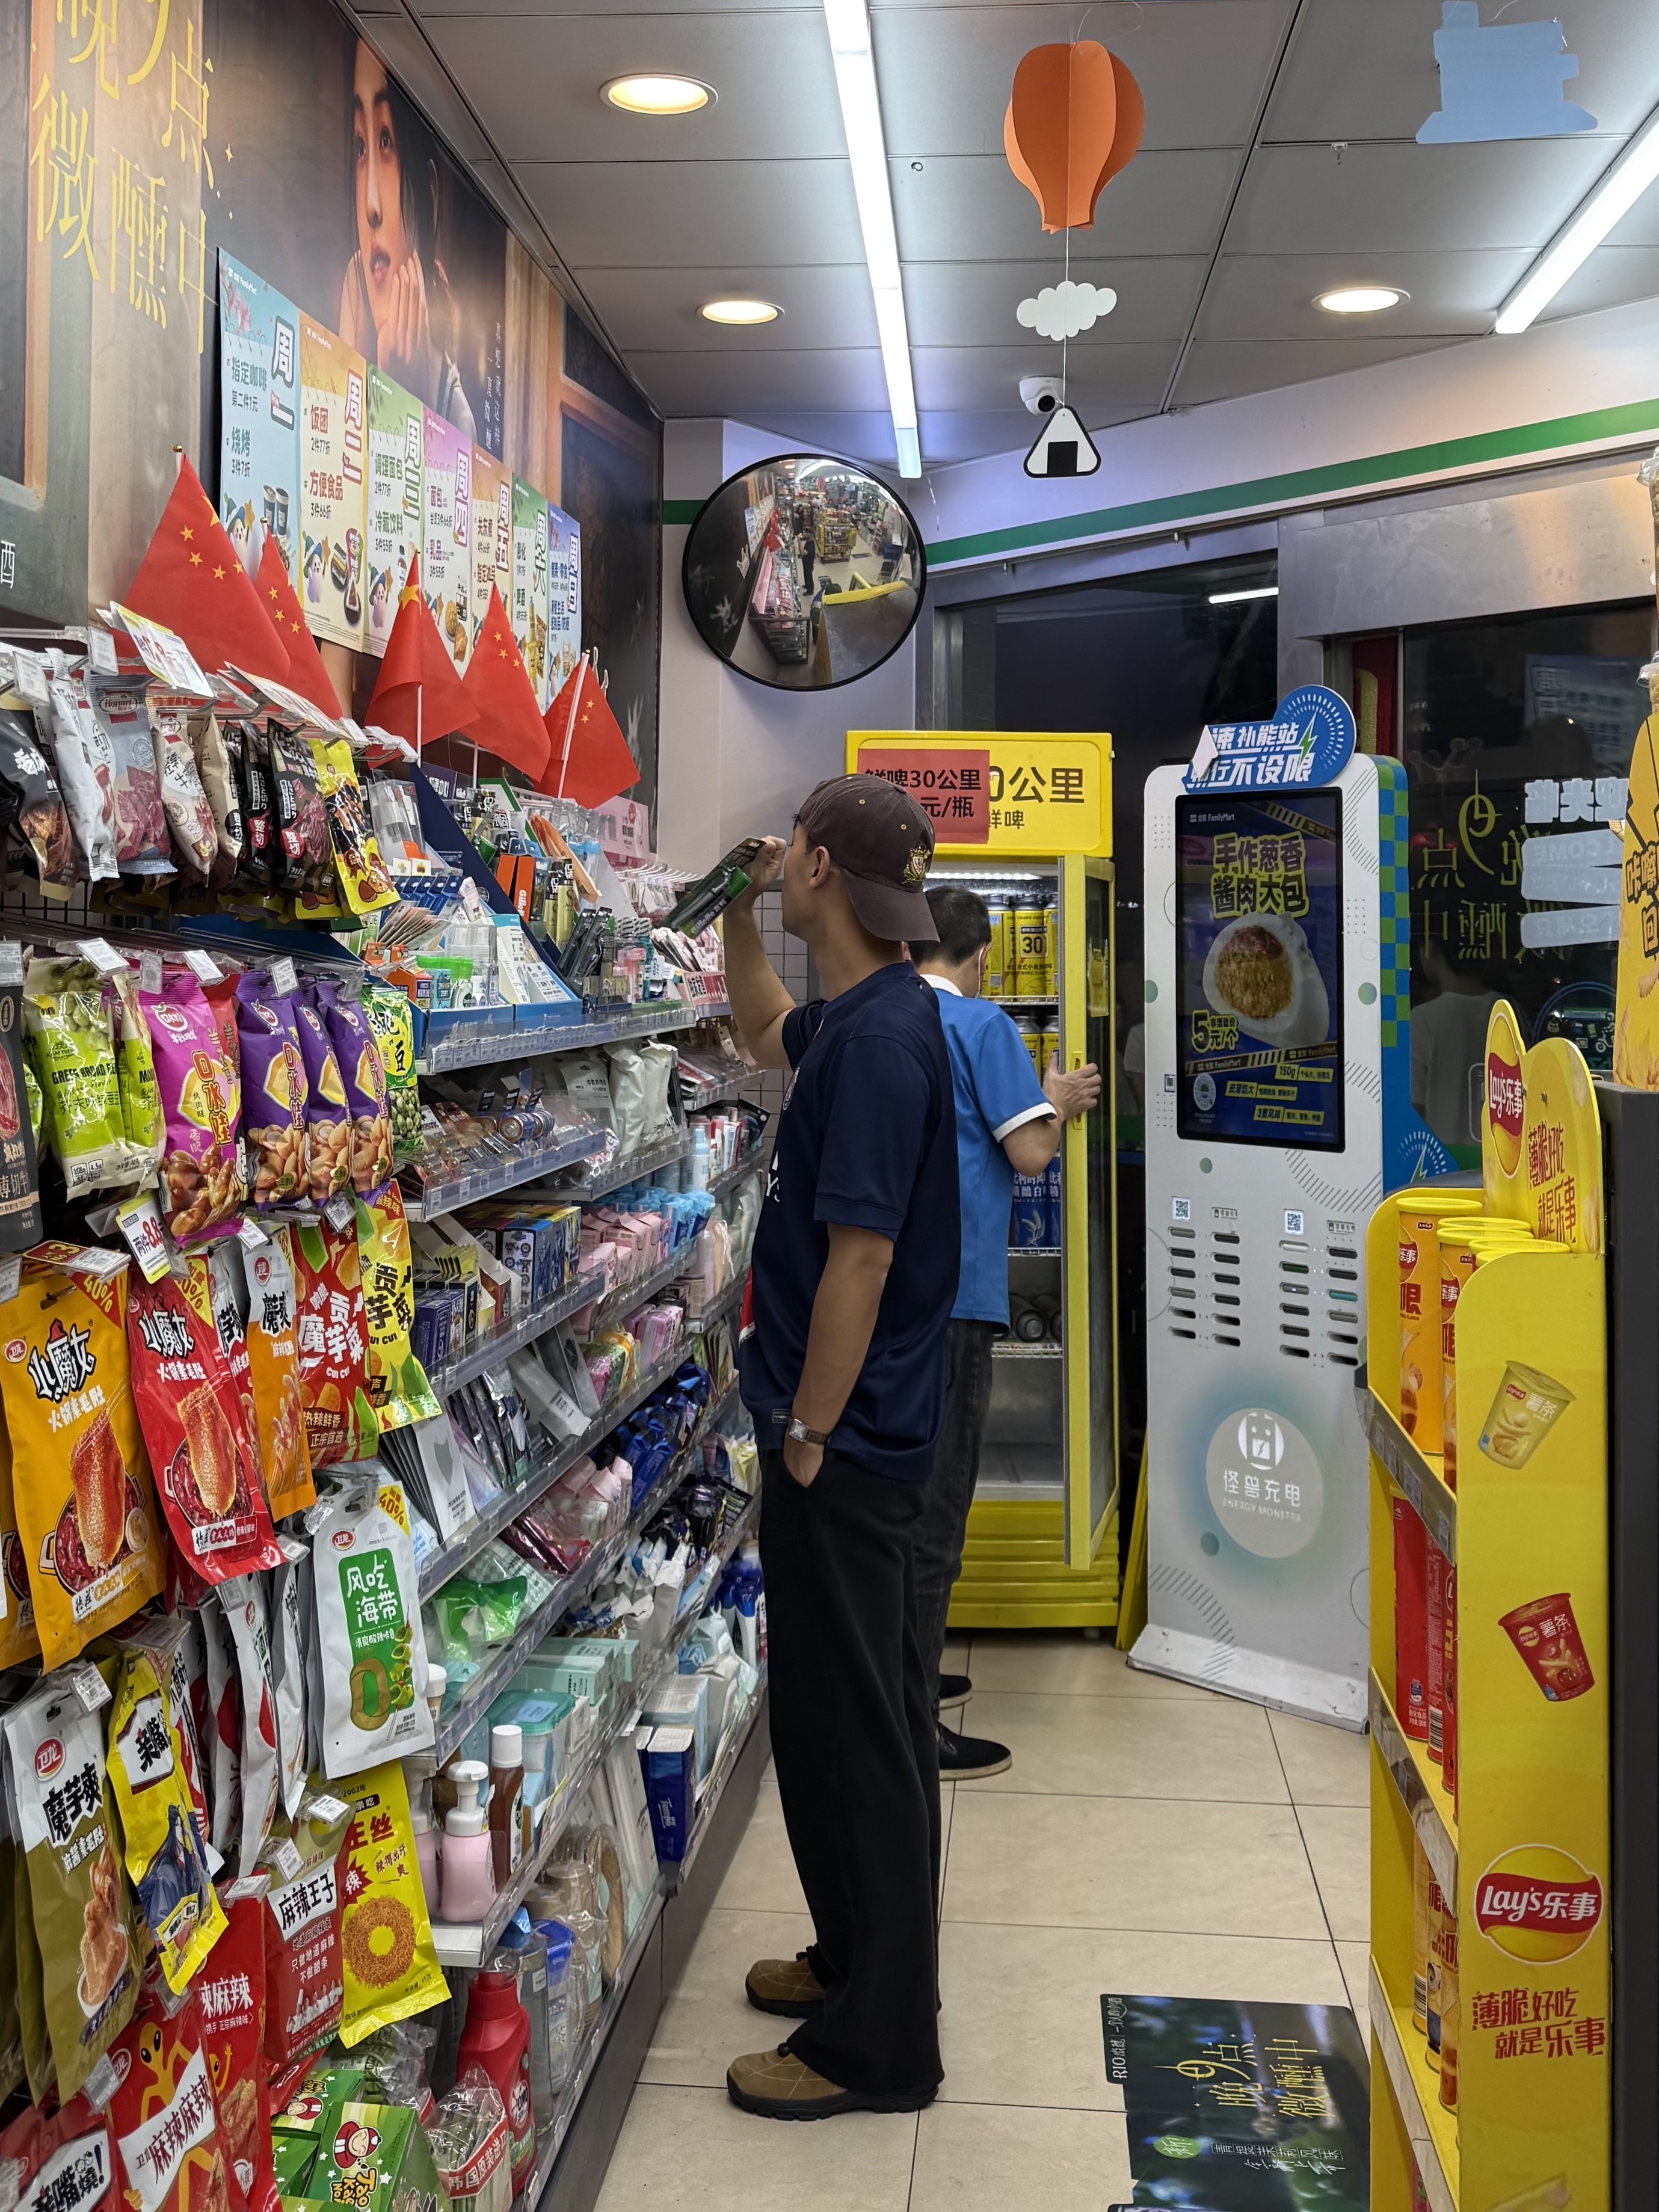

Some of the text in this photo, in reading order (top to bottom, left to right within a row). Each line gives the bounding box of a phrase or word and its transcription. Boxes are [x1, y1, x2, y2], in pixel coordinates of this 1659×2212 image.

[232, 355, 268, 392] 指定咖啡
[271, 315, 295, 431] 周一
[232, 390, 259, 413] 第二件1元
[310, 404, 328, 434] 饭团
[231, 426, 251, 458] 烧烤
[342, 369, 363, 485] 周二
[310, 470, 343, 501] 方便食品
[1190, 752, 1316, 786] 行不设限
[920, 796, 974, 819] 元/瓶
[1207, 813, 1236, 823] FamilyMart
[1214, 834, 1304, 877] 手作葱香
[1626, 842, 1659, 903] 咔嚓
[1022, 936, 1043, 954] 30
[1193, 1011, 1209, 1052] 5
[1210, 1029, 1237, 1049] 元/个
[1214, 1059, 1242, 1070] FamilyMart
[1279, 1066, 1296, 1080] 150g
[191, 1049, 232, 1146] 口水娃
[282, 1039, 305, 1130] 口水娃
[1489, 1068, 1523, 1120] Lay's 乐事
[1527, 1120, 1566, 1191] 薄脆好吃
[1537, 1175, 1577, 1245] 就是乐事
[83, 1273, 114, 1313] 40%
[381, 1332, 398, 1345] CUI
[156, 1361, 208, 1382] 火锅素毛肚
[47, 1388, 106, 1434] 火锅素毛肚
[1223, 1469, 1302, 1508] 怪兽充电
[379, 1493, 405, 1527] 40%
[1223, 1497, 1301, 1521] ENERGY MONSTER
[346, 1553, 390, 1599] 风吃
[356, 1590, 398, 1628] 海带
[1538, 1614, 1571, 1639] 薯条
[42, 1761, 103, 1845] 魔芋爽
[344, 1870, 363, 1896] 辣
[396, 1865, 410, 1878] 爽
[279, 1873, 335, 1932] 麻辣王子
[1480, 1885, 1599, 1922] Lay's 乐事
[291, 1934, 335, 1973] 只做地道麻辣
[300, 1956, 328, 1984] 不做甜条
[1471, 1986, 1580, 2032] 薄脆好吃
[1494, 2016, 1607, 2060] 就是乐事
[1111, 2056, 1129, 2079] RIO
[1152, 2041, 1267, 2107] 晚9点
[1264, 2038, 1336, 2119] 微醺中
[150, 2073, 213, 2186] 麻辣麻辣
[1213, 2142, 1342, 2160] 青提茉莉风味
[342, 2177, 357, 2207] Kae
[355, 2167, 377, 2208] Tao
